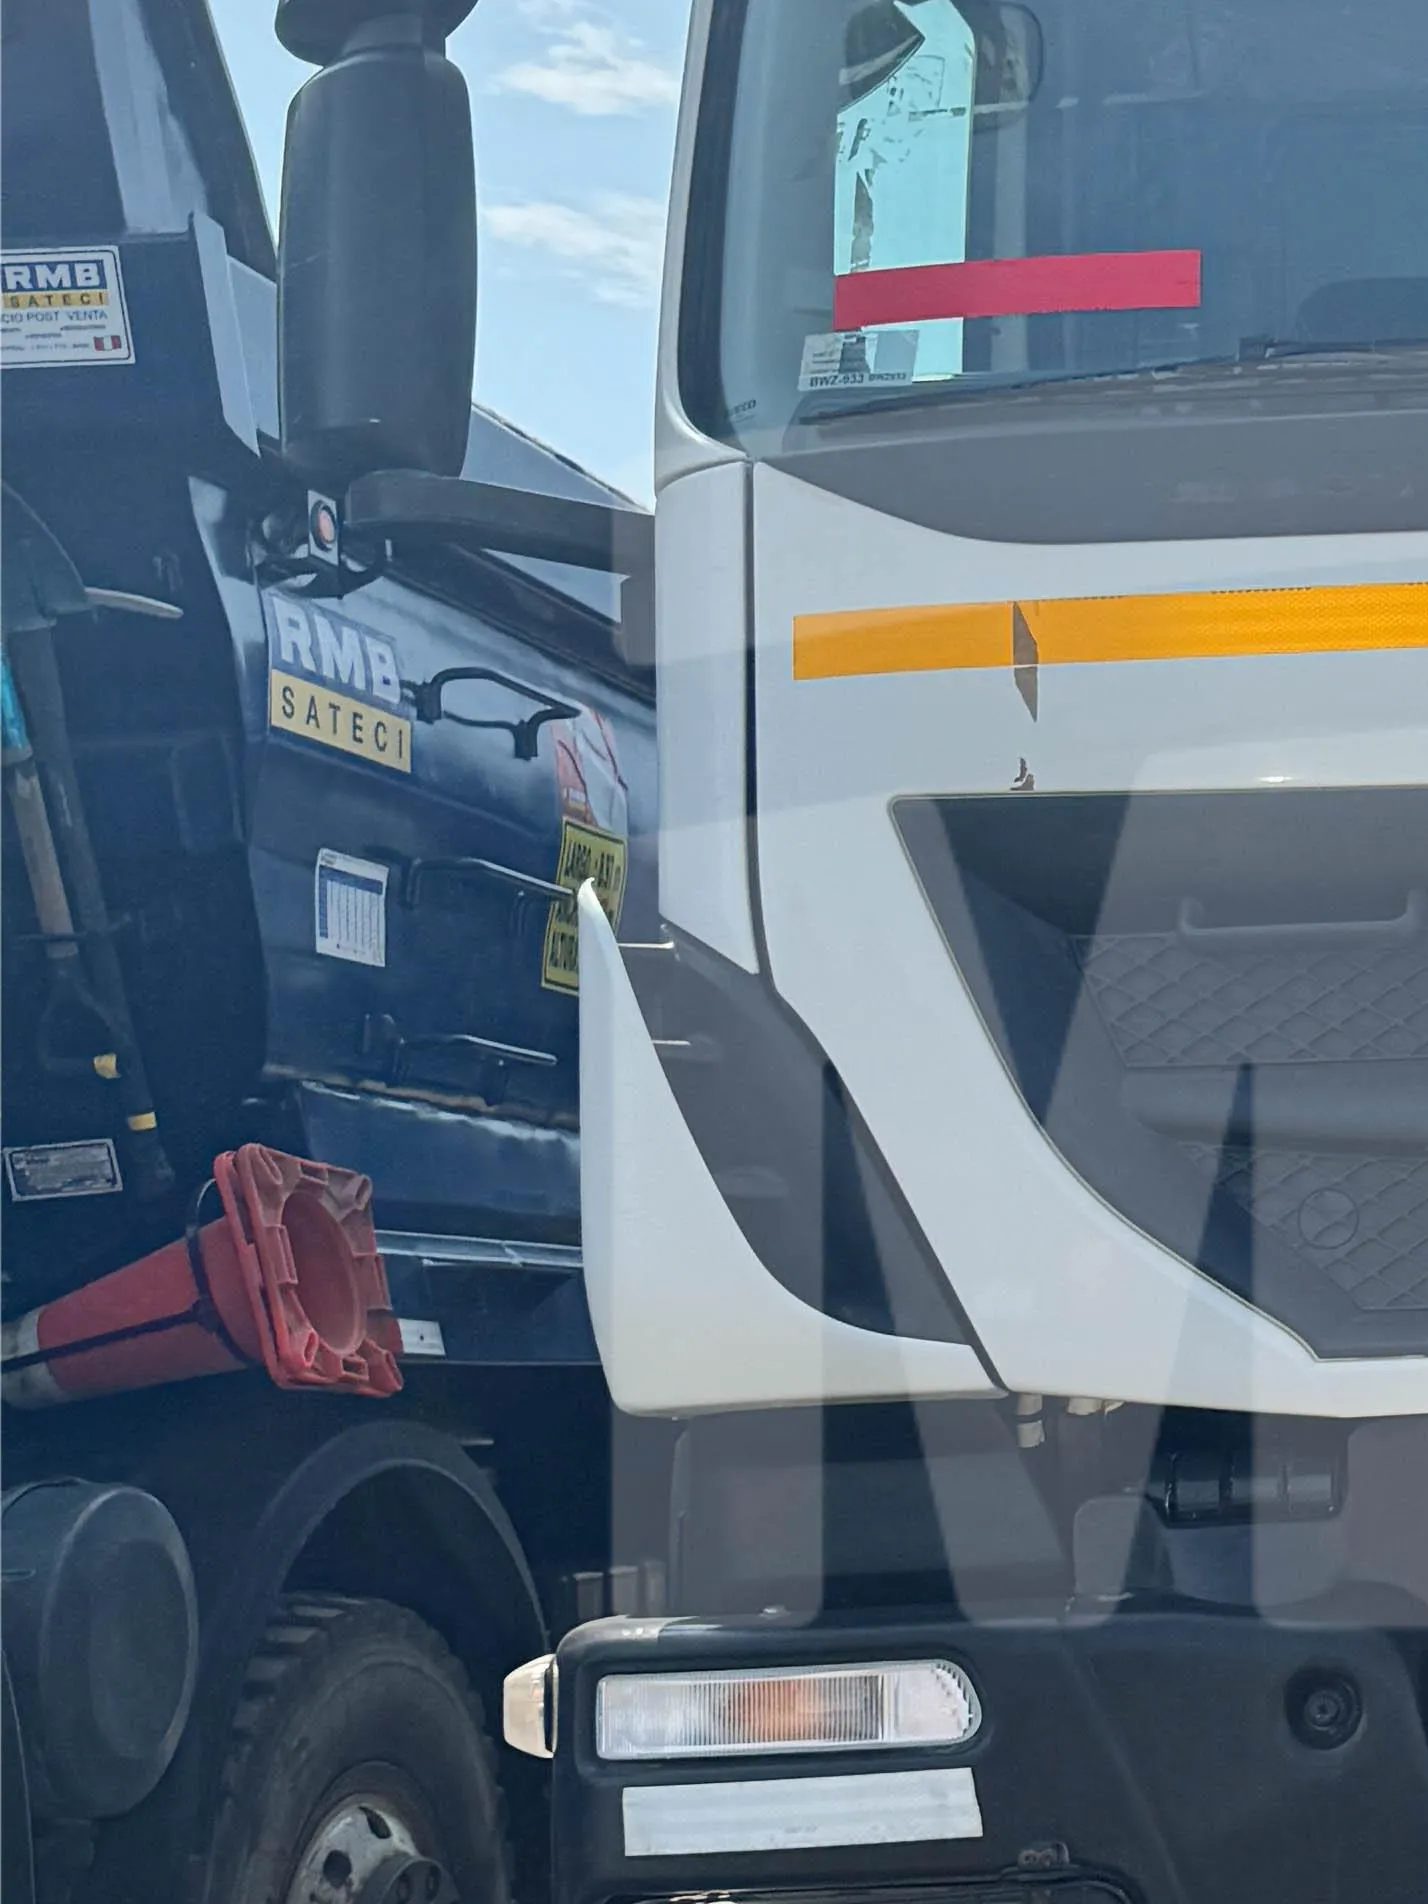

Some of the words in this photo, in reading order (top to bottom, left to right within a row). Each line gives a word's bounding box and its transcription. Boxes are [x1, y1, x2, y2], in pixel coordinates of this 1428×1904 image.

[4, 262, 101, 290] RMB
[272, 595, 401, 705] RMB
[281, 685, 403, 760] SATECI
